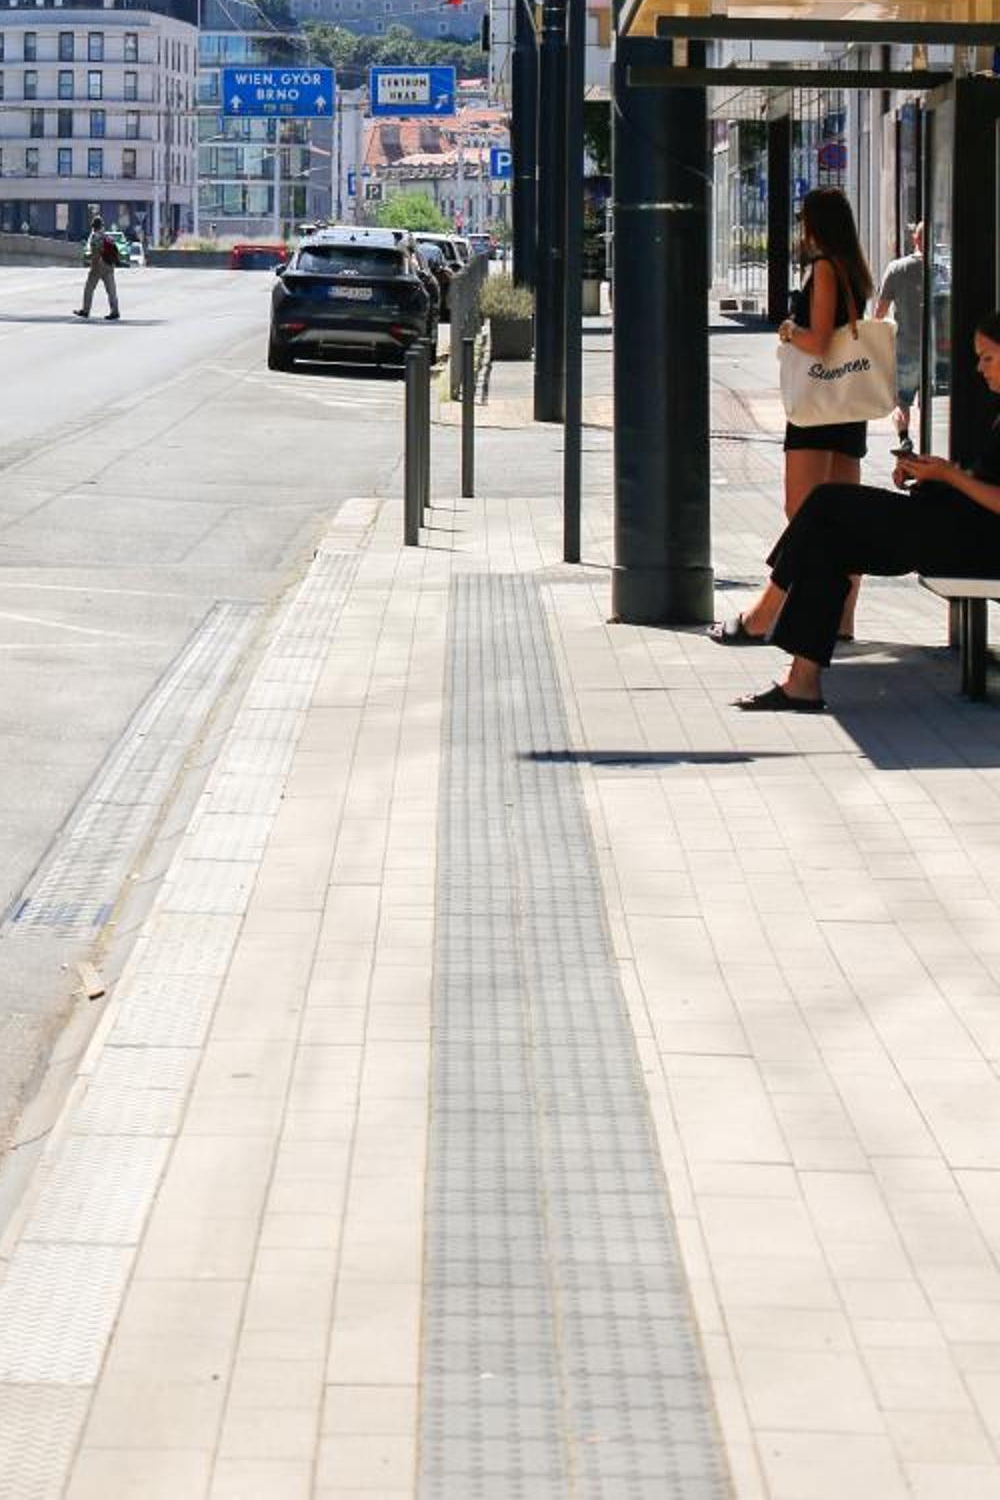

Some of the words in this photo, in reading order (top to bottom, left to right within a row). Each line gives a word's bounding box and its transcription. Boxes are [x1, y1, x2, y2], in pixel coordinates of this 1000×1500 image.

[235, 73, 277, 88] WIEN,
[256, 88, 300, 101] BRNO
[497, 151, 512, 175] P
